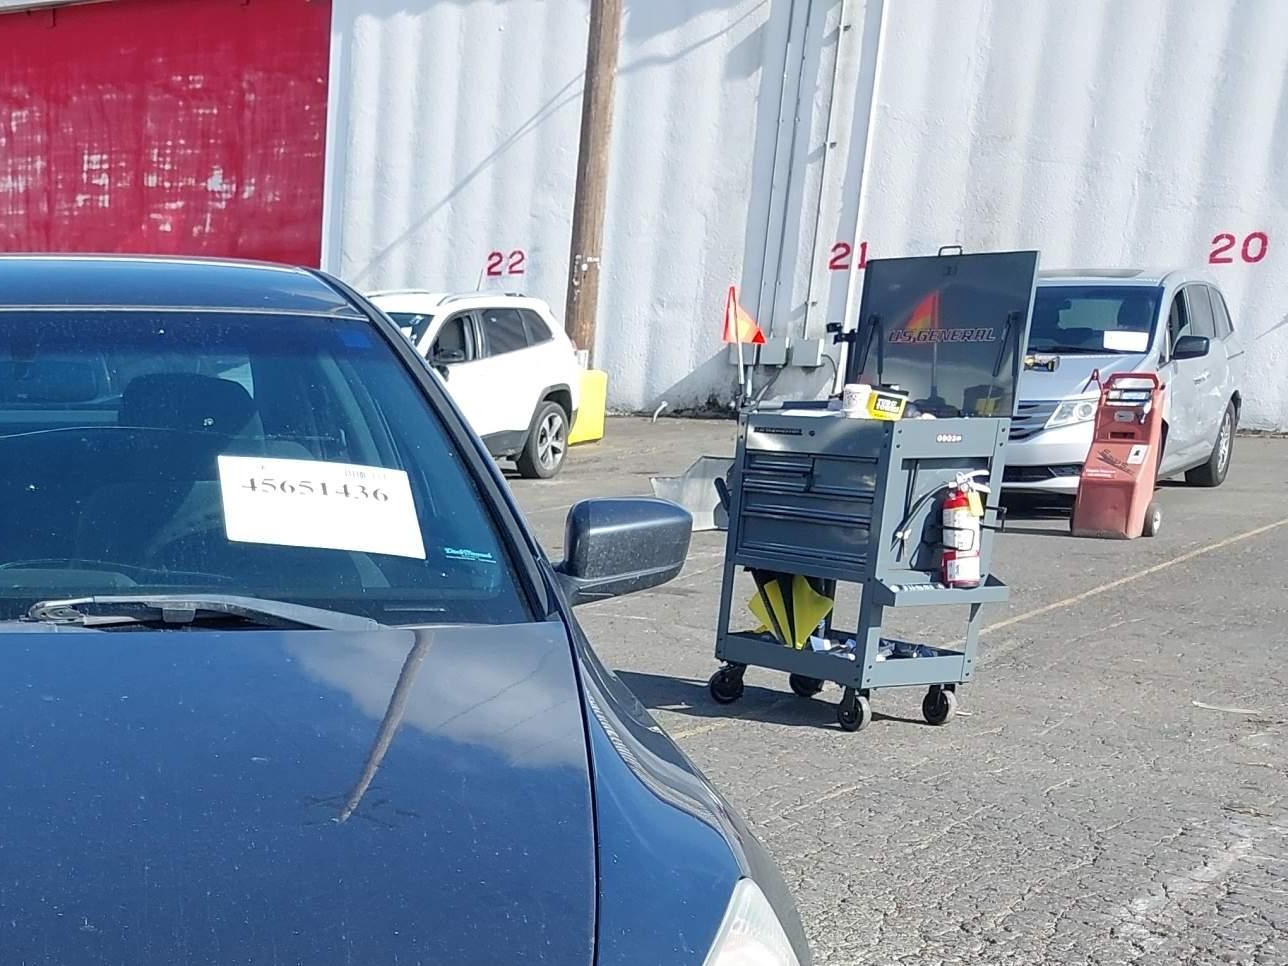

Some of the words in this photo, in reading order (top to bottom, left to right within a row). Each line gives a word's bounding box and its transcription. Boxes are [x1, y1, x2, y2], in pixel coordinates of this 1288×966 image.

[828, 241, 867, 270] 21
[1208, 231, 1268, 264] 20
[487, 250, 525, 276] 22
[240, 477, 390, 503] 45651436
